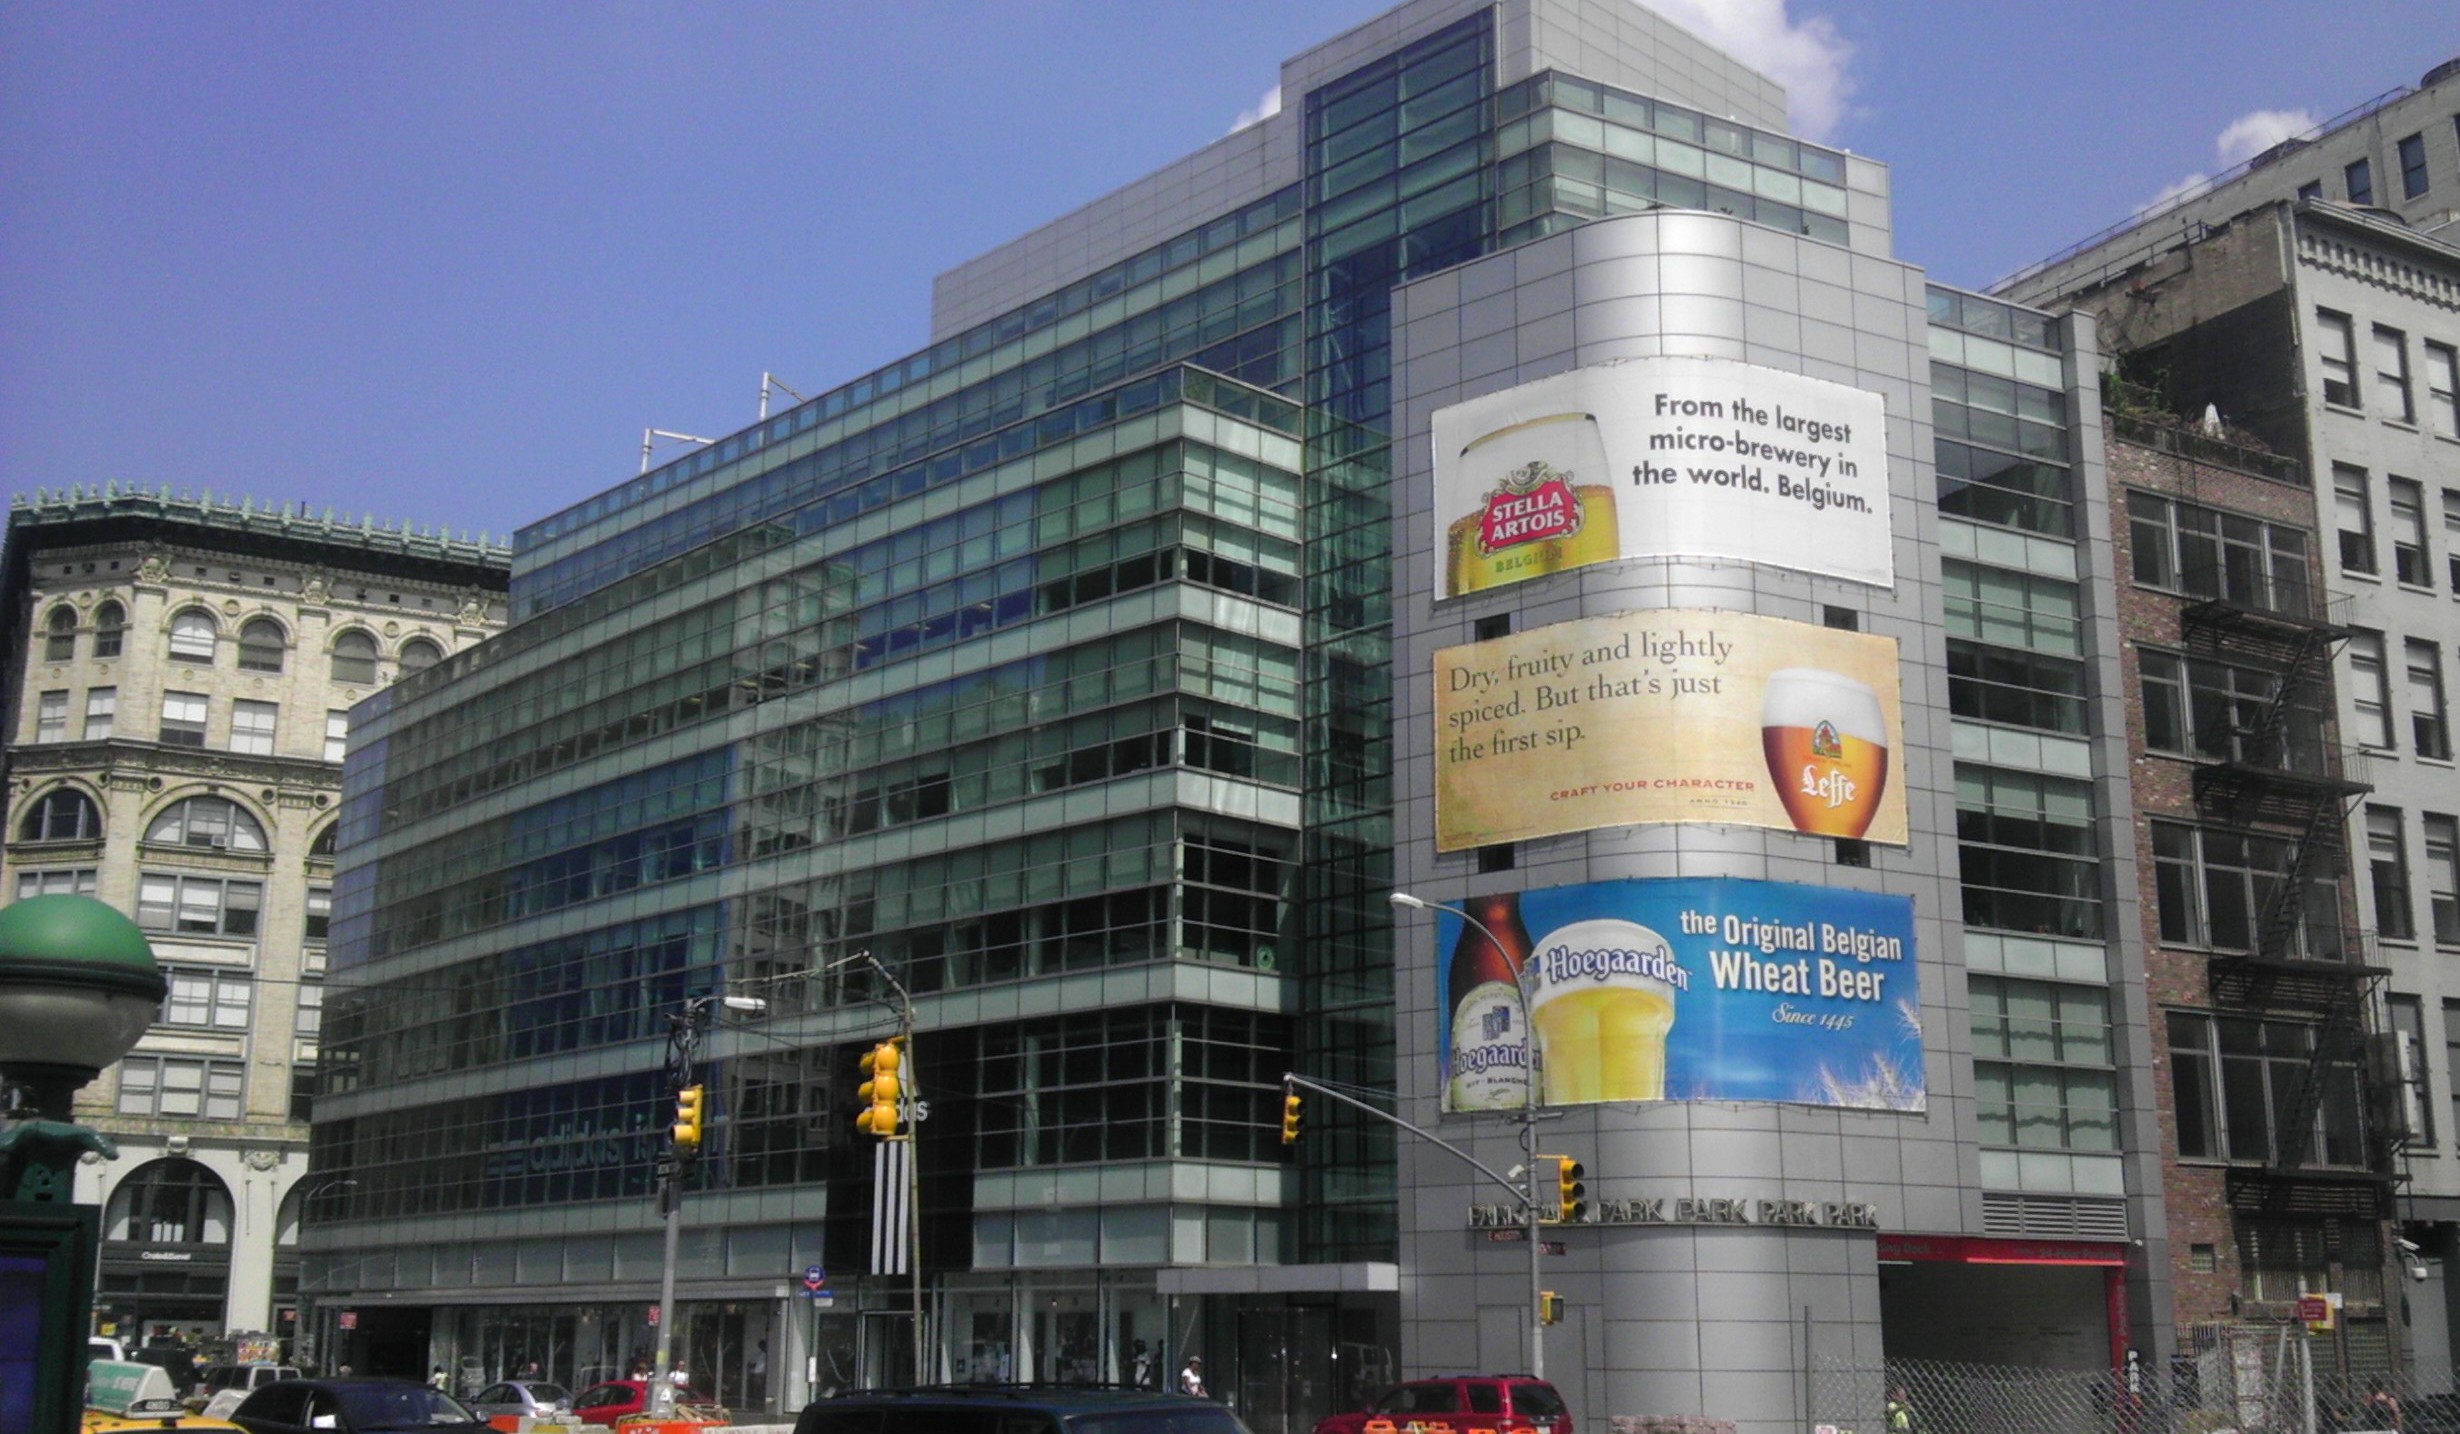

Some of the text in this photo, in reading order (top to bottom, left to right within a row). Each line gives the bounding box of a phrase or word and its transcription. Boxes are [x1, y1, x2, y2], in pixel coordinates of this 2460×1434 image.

[1655, 393, 1852, 443] From the largest
[1650, 428, 1858, 478] micro-brewery in
[1492, 491, 1564, 523] STELLA
[1633, 461, 1873, 514] the world. Belgium.
[1491, 509, 1566, 542] ARTOIS
[1496, 547, 1563, 573] BELGIUM
[1449, 630, 1734, 697] Dry, fruity and lightly
[1448, 668, 1723, 734] spiced. But that's just
[1449, 719, 1586, 764] the first sip.
[1550, 777, 1756, 802] CRAFT YOUR CHARACTER
[1801, 764, 1856, 809] Leffe
[1680, 909, 1903, 964] the Original Belgian
[1546, 944, 1690, 992] Hoegaarden
[1708, 950, 1886, 1002] Wheat Beer
[1771, 1003, 1855, 1031] Since 1445
[529, 1121, 620, 1169] adidas
[1597, 1199, 1667, 1223] PARK
[1677, 1199, 1749, 1224] PARK
[1757, 1200, 1818, 1225] PARK
[1823, 1203, 1877, 1227] PARK
[2128, 1350, 2140, 1393] PARK
